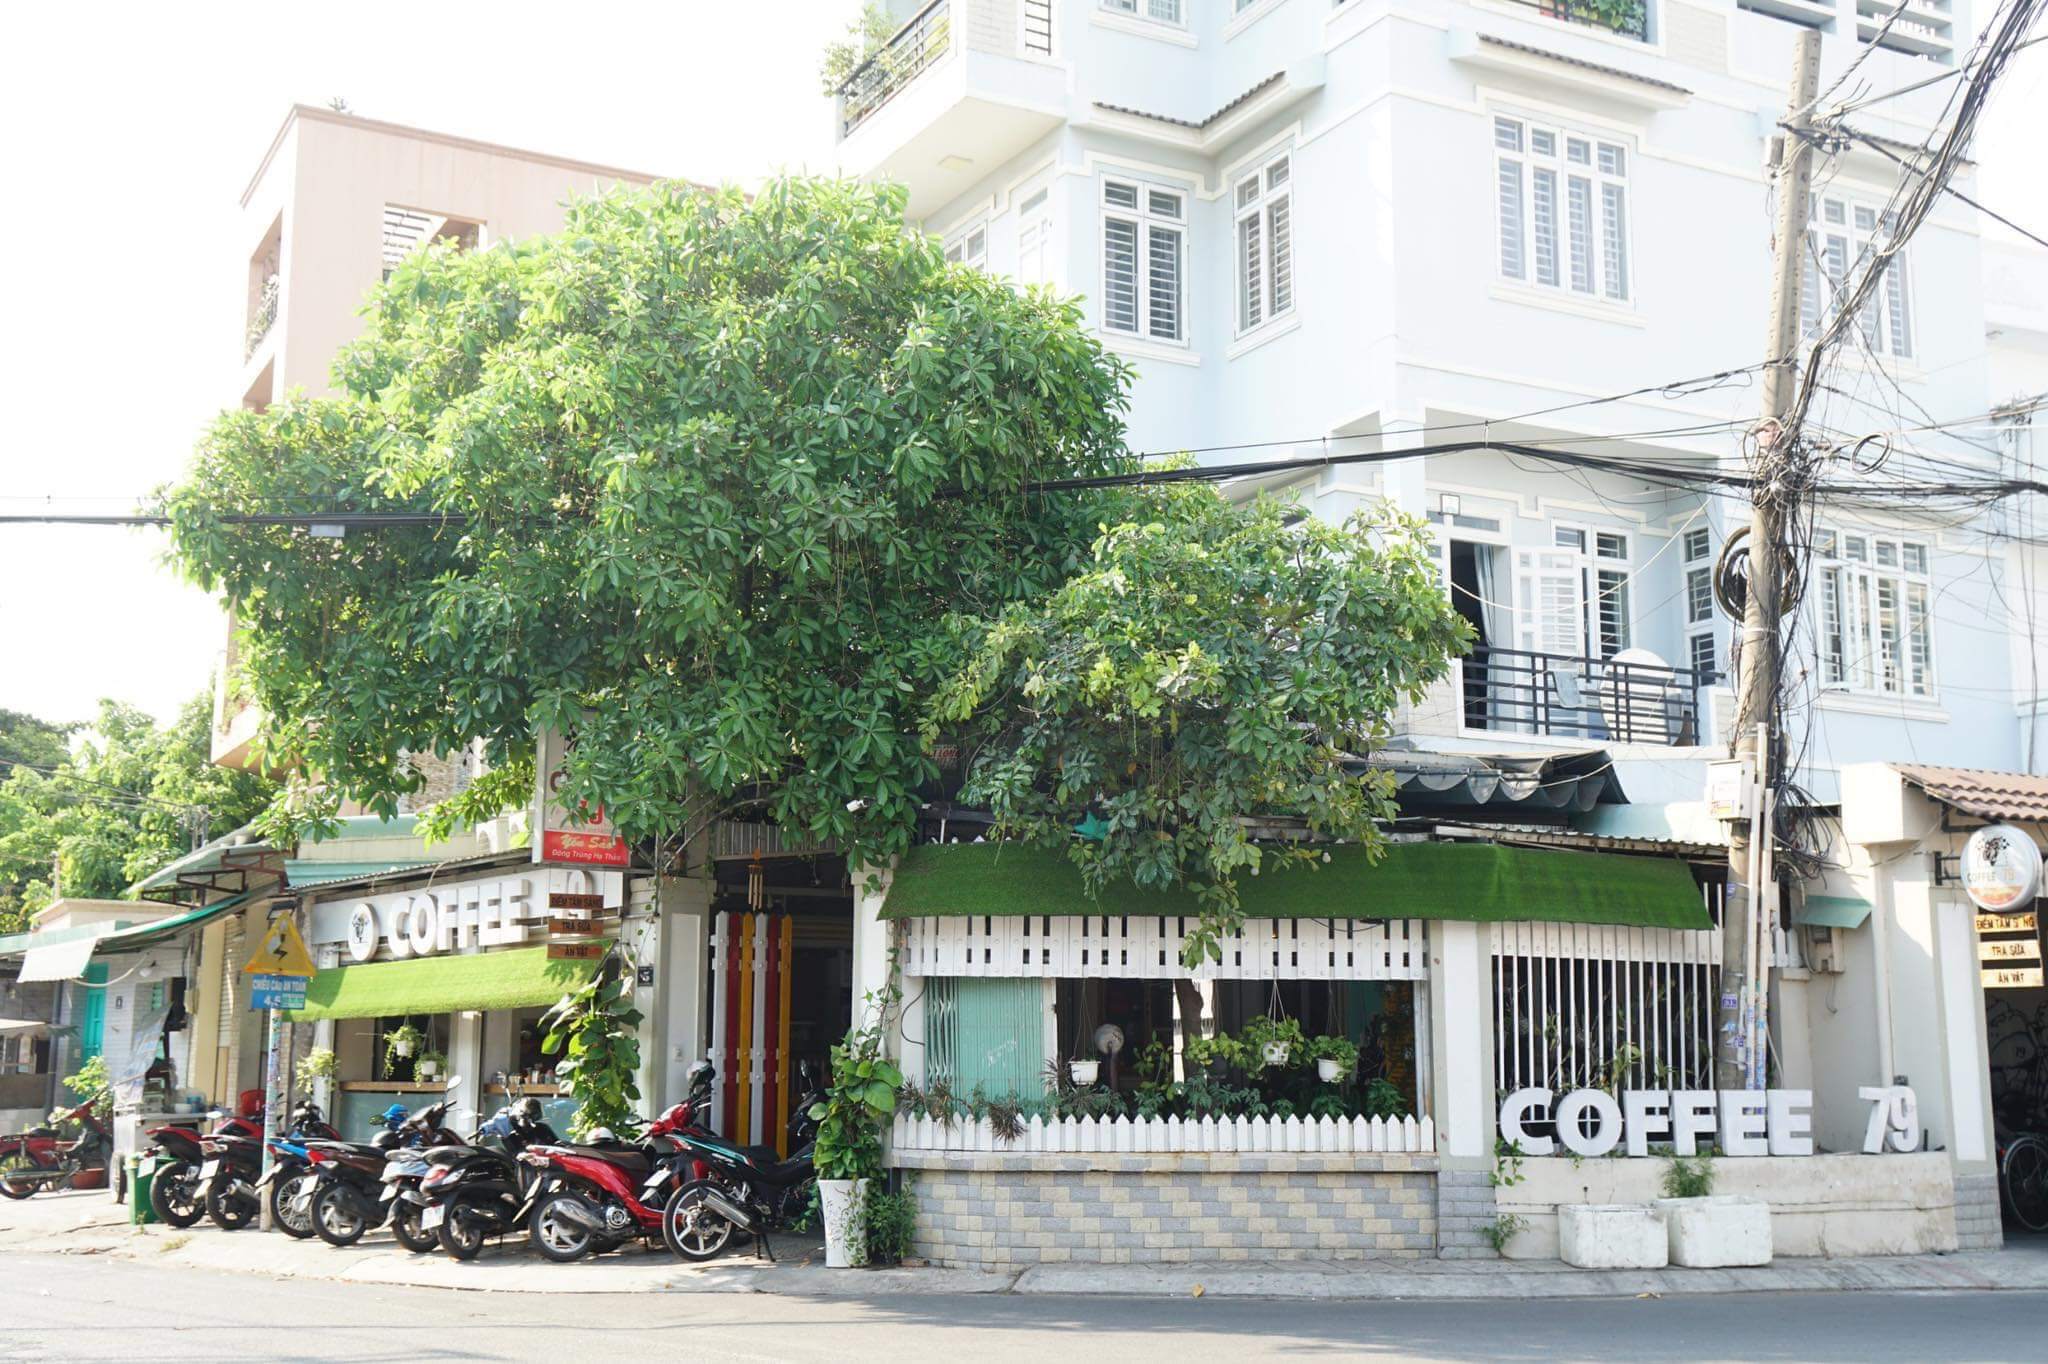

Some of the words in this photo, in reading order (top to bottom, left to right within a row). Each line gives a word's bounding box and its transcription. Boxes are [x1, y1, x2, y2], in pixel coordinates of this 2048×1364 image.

[388, 879, 528, 957] COFFEE
[1500, 1087, 1813, 1156] COFFEE
[1859, 1086, 1920, 1154] 79
